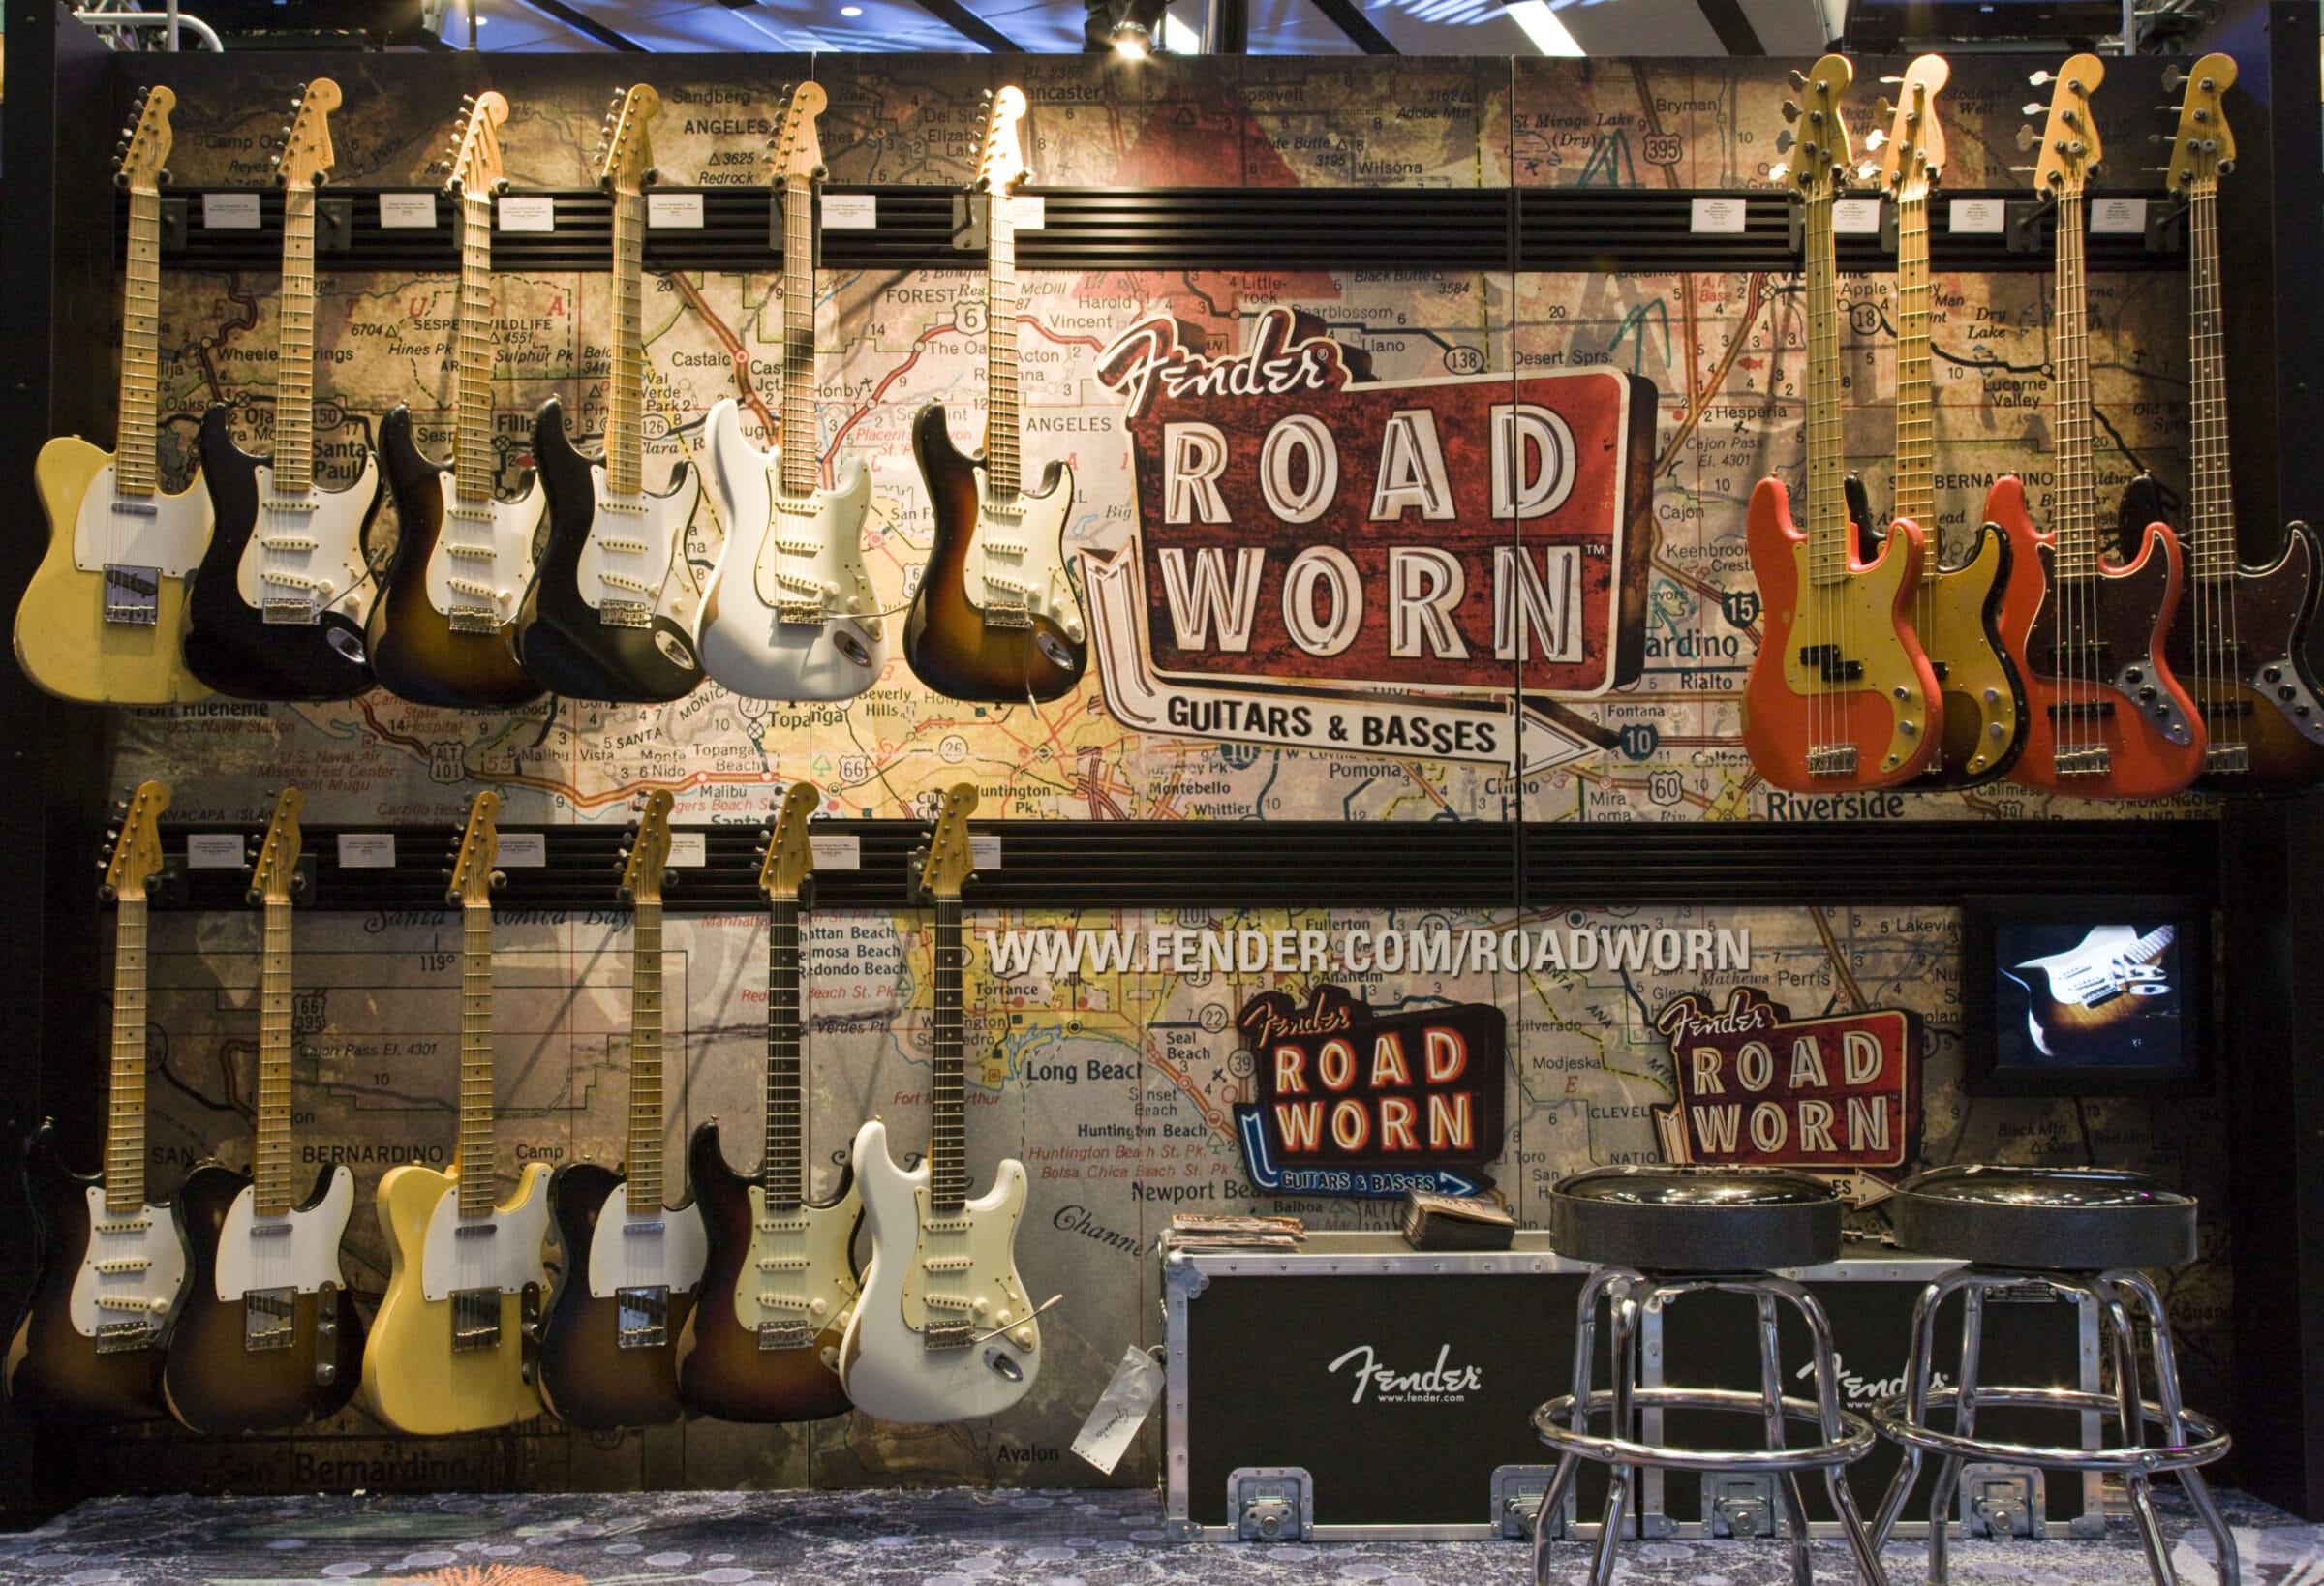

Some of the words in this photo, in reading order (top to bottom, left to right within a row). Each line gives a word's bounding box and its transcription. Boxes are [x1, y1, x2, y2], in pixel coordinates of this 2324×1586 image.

[671, 89, 750, 105] Sandberg
[1397, 106, 1438, 119] Adobe
[1443, 106, 1470, 119] Mtn
[1656, 98, 1717, 114] Bryman
[1960, 103, 1994, 116] Well
[925, 108, 951, 123] Del
[1514, 114, 1529, 128] El
[1536, 113, 1591, 129] Mirage
[1597, 113, 1634, 126] Lake
[684, 120, 769, 134] ANGELES
[206, 135, 253, 150] Camp
[1293, 137, 1330, 150] Butte
[1552, 132, 1596, 148] (Dry)
[1648, 139, 1678, 158] 395
[723, 152, 754, 165] 3625
[1315, 154, 1346, 167] 3195
[229, 161, 269, 173] Reyes
[1358, 161, 1423, 174] Wilsona
[699, 171, 754, 184] Redrock
[657, 280, 674, 291] 20
[1021, 282, 1067, 294] McDill
[1243, 278, 1288, 291] Little-
[1439, 282, 1470, 293] 3584
[1841, 283, 1886, 296] Apple
[886, 289, 954, 303] FOREST
[1079, 294, 1132, 309] Harold
[1244, 292, 1278, 306] rock
[1700, 290, 1731, 301] Base
[1936, 295, 1964, 307] Man
[1293, 305, 1393, 320] Pearblossom
[1549, 306, 1566, 319] 20
[1855, 311, 1875, 327] 18
[1976, 308, 2006, 321] Dry
[413, 320, 459, 331] SESPE
[1050, 314, 1112, 328] Vincent
[352, 324, 382, 337] 6704
[872, 324, 885, 337] 14
[1968, 327, 2005, 339] Lake
[504, 332, 532, 344] 4551
[1362, 338, 1405, 352] Llano
[389, 344, 430, 355] Hines
[436, 344, 452, 355] Pk
[929, 342, 960, 354] The
[495, 350, 551, 363] Sulphur
[556, 349, 573, 361] Pk
[672, 353, 731, 367] Castaic
[1017, 350, 1059, 362] Acton
[1099, 309, 1325, 417] Fender
[1452, 351, 1478, 369] 138
[1514, 351, 1564, 366] Desert
[1573, 350, 1614, 367] Sprs.
[647, 373, 668, 385] Val
[1983, 379, 2047, 391] Lucerne
[641, 387, 680, 399] Verde
[166, 396, 206, 411] Oaks
[646, 400, 679, 412] Park
[1993, 394, 2040, 409] Valley
[1716, 406, 1787, 420] Hesperia
[642, 420, 664, 434] 126
[1027, 417, 1112, 431] ANGELES
[313, 441, 366, 458] Santa
[1686, 437, 1726, 450] Cajon
[1731, 437, 1763, 449] Pass
[1165, 403, 1577, 524] ROAD
[1698, 454, 1717, 467] El.
[1722, 454, 1751, 466] 4301
[1715, 479, 1730, 491] 10
[892, 507, 916, 519] San
[1106, 505, 1131, 522] Big
[1660, 504, 1704, 521] Cajon
[1159, 545, 1583, 663] WORN
[1681, 674, 1732, 690] Rialto
[859, 688, 911, 703] Beverly
[404, 707, 438, 718] State
[769, 702, 843, 728] Topanga
[866, 704, 899, 717] Hills
[1608, 705, 1665, 717] Fontana
[406, 719, 464, 735] Hospital
[1168, 697, 1311, 737] GUITARS
[1328, 716, 1349, 741] &
[1362, 716, 1497, 754] BASSES
[521, 748, 569, 762] Malibu
[580, 748, 614, 762] Vista
[641, 749, 687, 762] Monte
[693, 744, 755, 759] Topanga
[258, 766, 306, 777] Missile
[435, 765, 459, 778] 101
[653, 764, 686, 777] Nido
[716, 759, 760, 772] Beach
[844, 761, 863, 777] 66
[1330, 763, 1401, 778] Pomona
[328, 778, 370, 793] Mugu
[700, 784, 747, 798] Malibu
[1150, 781, 1231, 796] Montebello
[713, 798, 751, 811] Beach
[1590, 792, 1626, 807] Mira
[1767, 791, 1905, 821] Riverside
[1016, 801, 1037, 814] Pk.
[1194, 802, 1252, 816] Whittier
[1306, 918, 1370, 931] Fullerton
[850, 927, 895, 941] Beach
[855, 945, 902, 959] Beach
[987, 929, 1751, 973] WWW.FENDER.COM/ROADWORN
[865, 961, 908, 977] Beach
[1321, 970, 1383, 984] Anaheim
[1700, 971, 1770, 987] Mathews
[1778, 968, 1832, 987] Perris
[975, 983, 1039, 997] Torrance
[297, 1015, 323, 1030] 395
[1244, 992, 1351, 1049] Fender
[1663, 992, 1765, 1043] Fender
[1517, 1020, 1582, 1034] Silverado
[1167, 1031, 1197, 1046] Seal
[299, 1044, 341, 1058] Cajon
[345, 1043, 379, 1057] Pass
[407, 1042, 437, 1056] 4301
[1168, 1046, 1211, 1061] Beach
[1273, 1027, 1467, 1095] ROAD
[1533, 1056, 1602, 1072] Modjeska
[1694, 1031, 1884, 1095] ROAD
[1026, 1061, 1078, 1085] Long
[1134, 1102, 1178, 1116] Beach
[1273, 1092, 1476, 1153] WORN
[1694, 1095, 1891, 1156] WORN
[1078, 1123, 1156, 1140] Huntington
[1162, 1123, 1208, 1138] Beach
[303, 1145, 444, 1163] BERNARDINO
[516, 1144, 565, 1161] Camp
[1029, 1145, 1111, 1162] Huntington
[1114, 1145, 1157, 1160] Beach
[1162, 1145, 1180, 1159] St.
[1185, 1145, 1208, 1159] Pk.
[1514, 1150, 1546, 1164] Toro
[1042, 1164, 1080, 1179] Bolsa
[1086, 1164, 1127, 1178] Chica
[1282, 1169, 1350, 1190] GUITARS
[1356, 1175, 1365, 1190] &
[1372, 1173, 1434, 1193] BASSES
[1132, 1181, 1214, 1205] Newport
[1273, 1200, 1323, 1214] Balboa
[1054, 1205, 1156, 1257] Channel
[1329, 1344, 1481, 1403] Fender
[1378, 1392, 1465, 1403] www.fender.com
[997, 1445, 1060, 1463] Avalon
